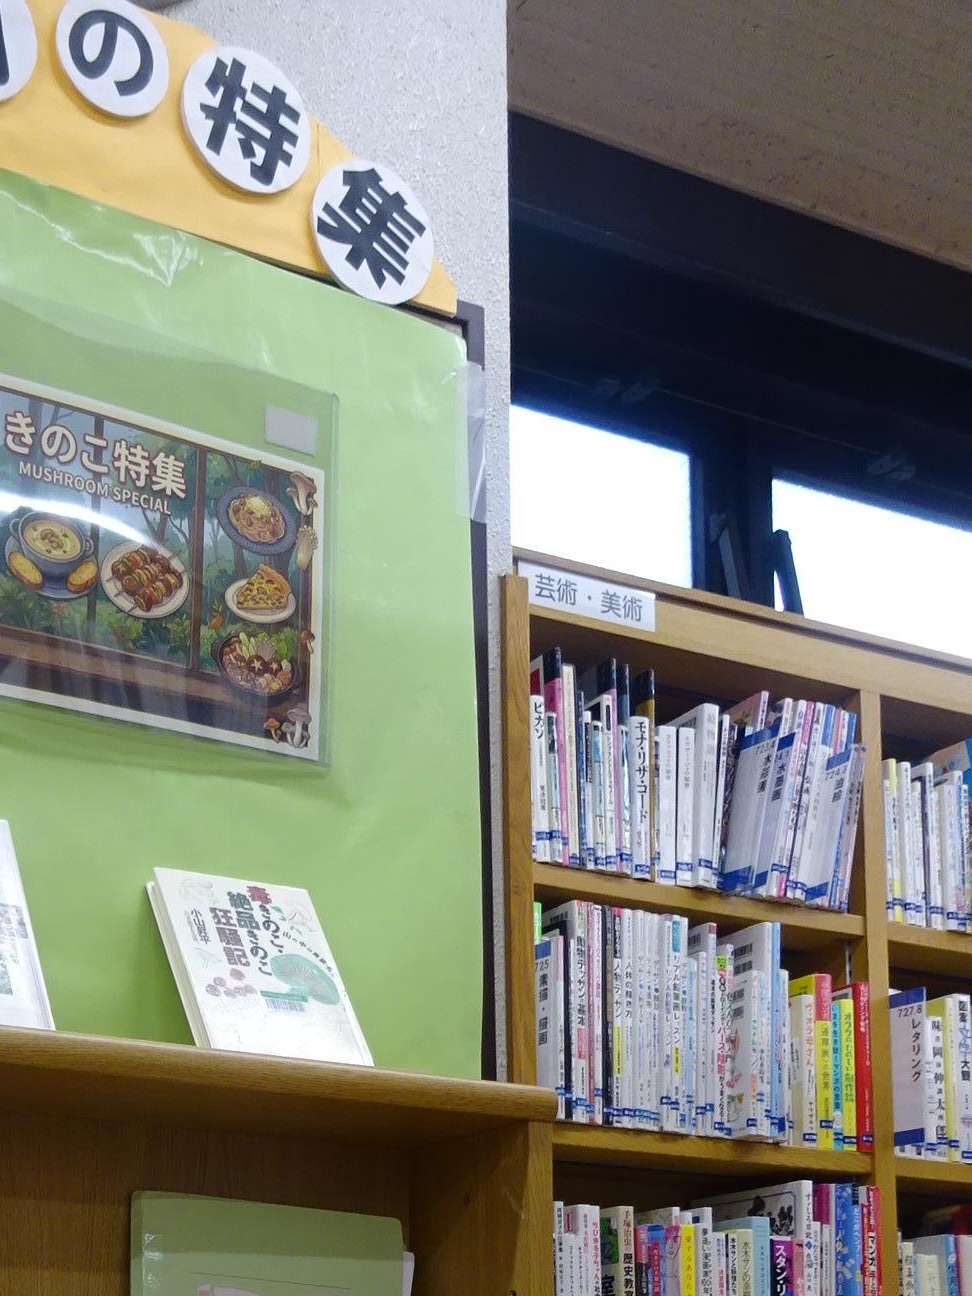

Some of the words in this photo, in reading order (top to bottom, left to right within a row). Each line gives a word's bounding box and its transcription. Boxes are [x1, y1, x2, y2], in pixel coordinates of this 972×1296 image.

[3, 410, 188, 500] きのこ特集
[18, 460, 109, 497] MUSHROOM
[113, 484, 172, 516] SPECIAL
[533, 572, 643, 623] 芸術・美術
[635, 720, 648, 824] モナ・リサ・コード
[910, 1018, 922, 1083] レタリング
